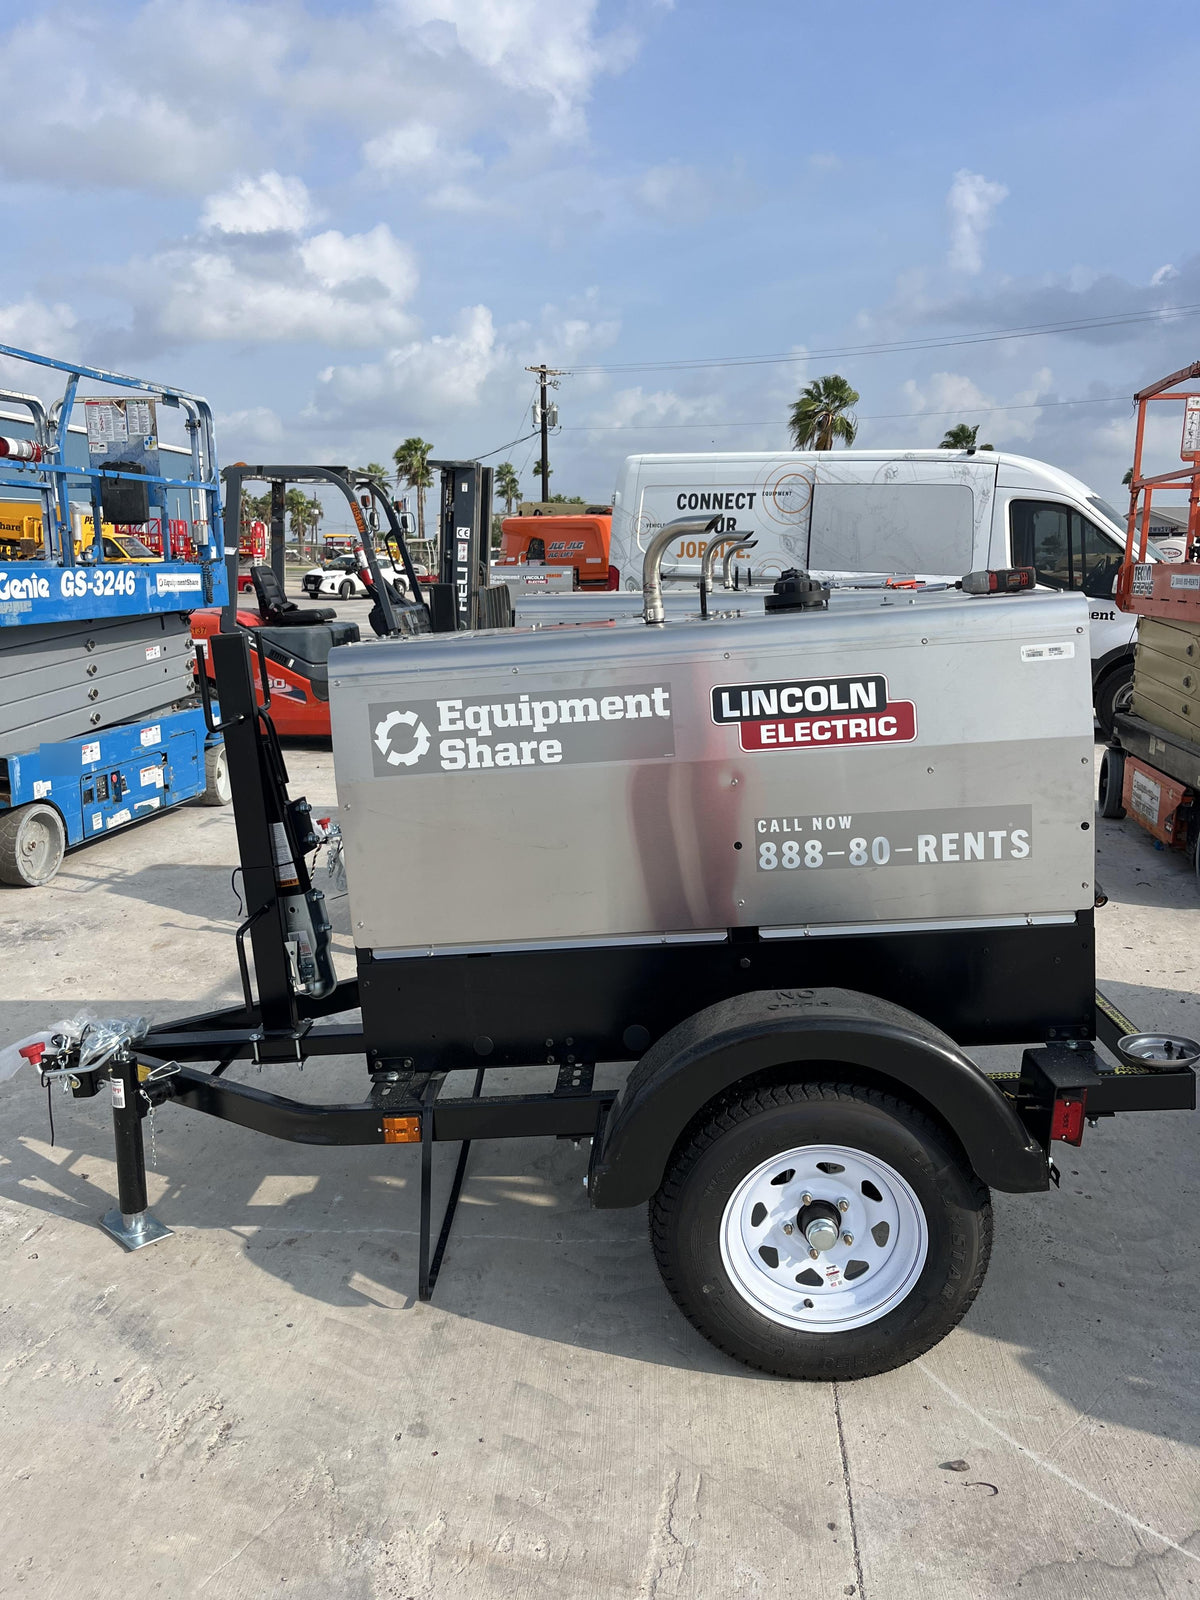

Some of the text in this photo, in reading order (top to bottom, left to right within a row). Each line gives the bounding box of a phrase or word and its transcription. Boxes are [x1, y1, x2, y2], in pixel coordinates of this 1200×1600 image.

[676, 492, 756, 510] CONNECT
[0, 522, 21, 531] hare
[713, 517, 737, 534] UR
[548, 541, 585, 550] JLG JLG
[0, 570, 135, 600] Genie GS-3246
[163, 579, 199, 587] EquipmentShare
[455, 566, 469, 611] HELI
[1089, 611, 1115, 621] ent
[436, 687, 670, 736] Equipment
[721, 682, 877, 718] LINCOLN
[760, 716, 898, 744] ELECTRIC
[439, 737, 563, 770] Share
[757, 815, 853, 833] CALL NOW
[758, 829, 1030, 870] 888-80-RENTS
